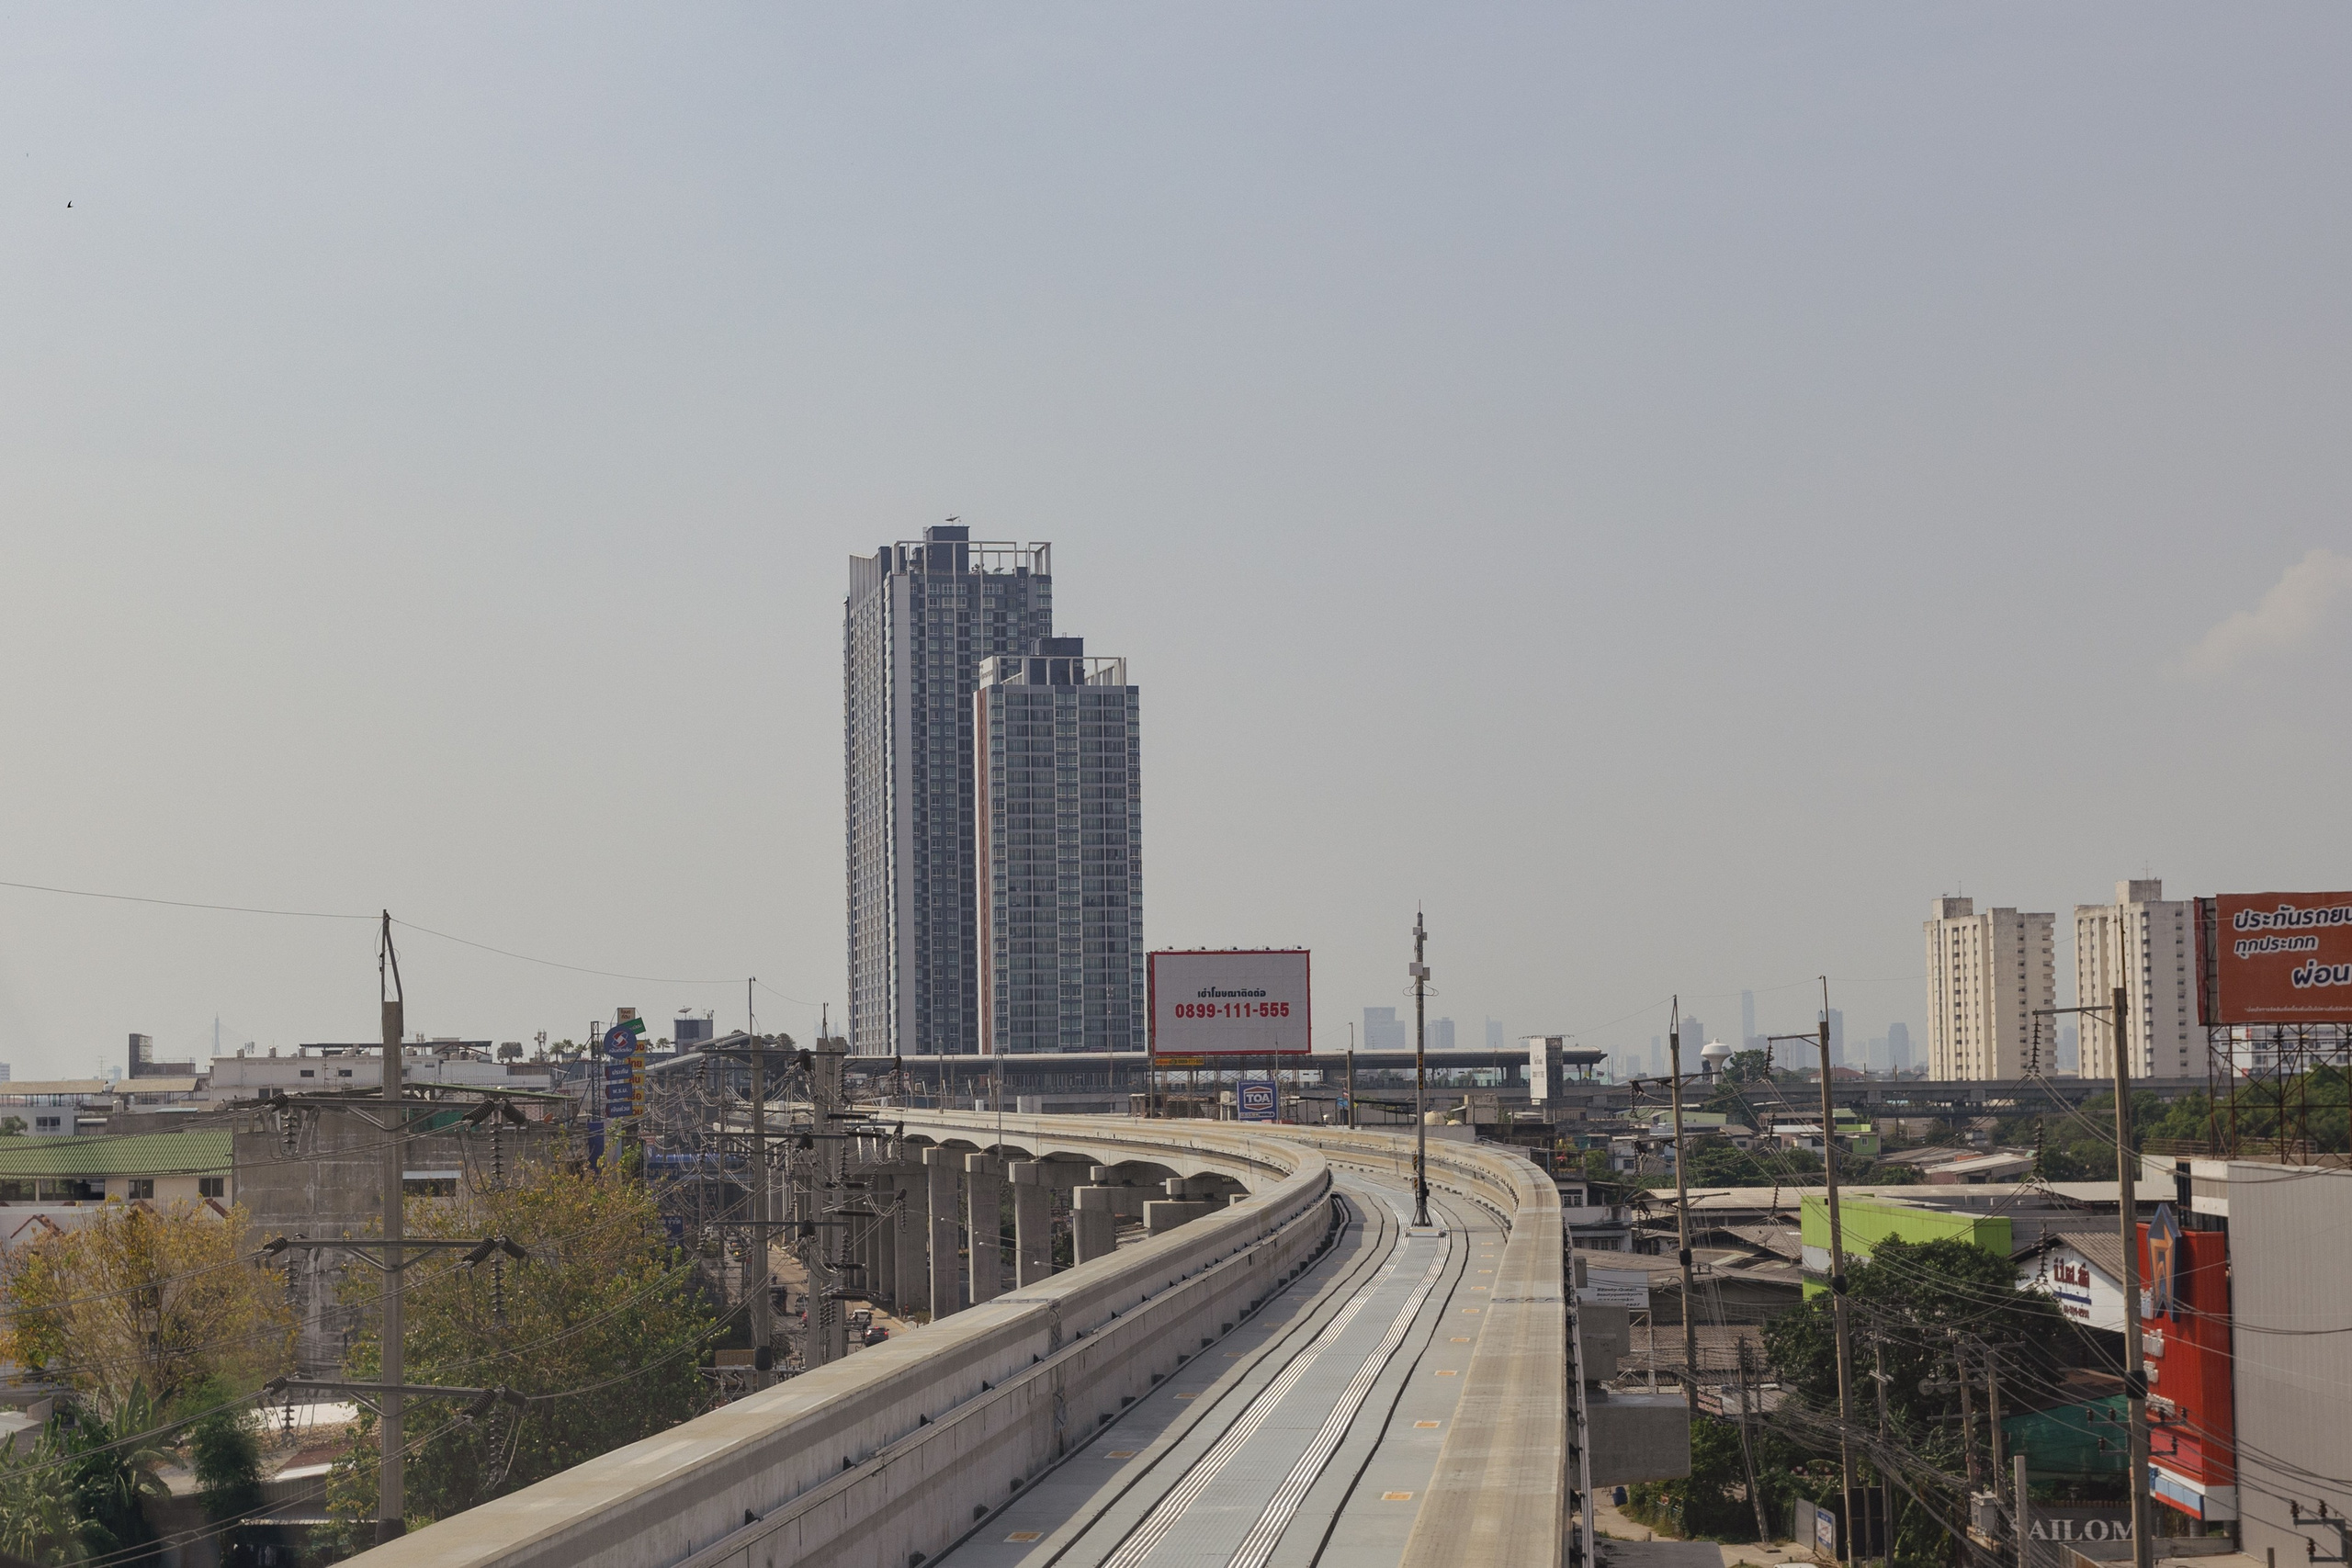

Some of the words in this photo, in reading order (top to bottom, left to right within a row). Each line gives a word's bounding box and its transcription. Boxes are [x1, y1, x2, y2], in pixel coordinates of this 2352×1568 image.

[2234, 936, 2316, 957] ทุกประเภท
[2292, 961, 2350, 986] ผ่อน
[1197, 987, 1267, 998] เช่าโฆษณาติดต่อ
[1175, 1002, 1290, 1019] 0899-111-555
[1246, 1093, 1271, 1103] TOA
